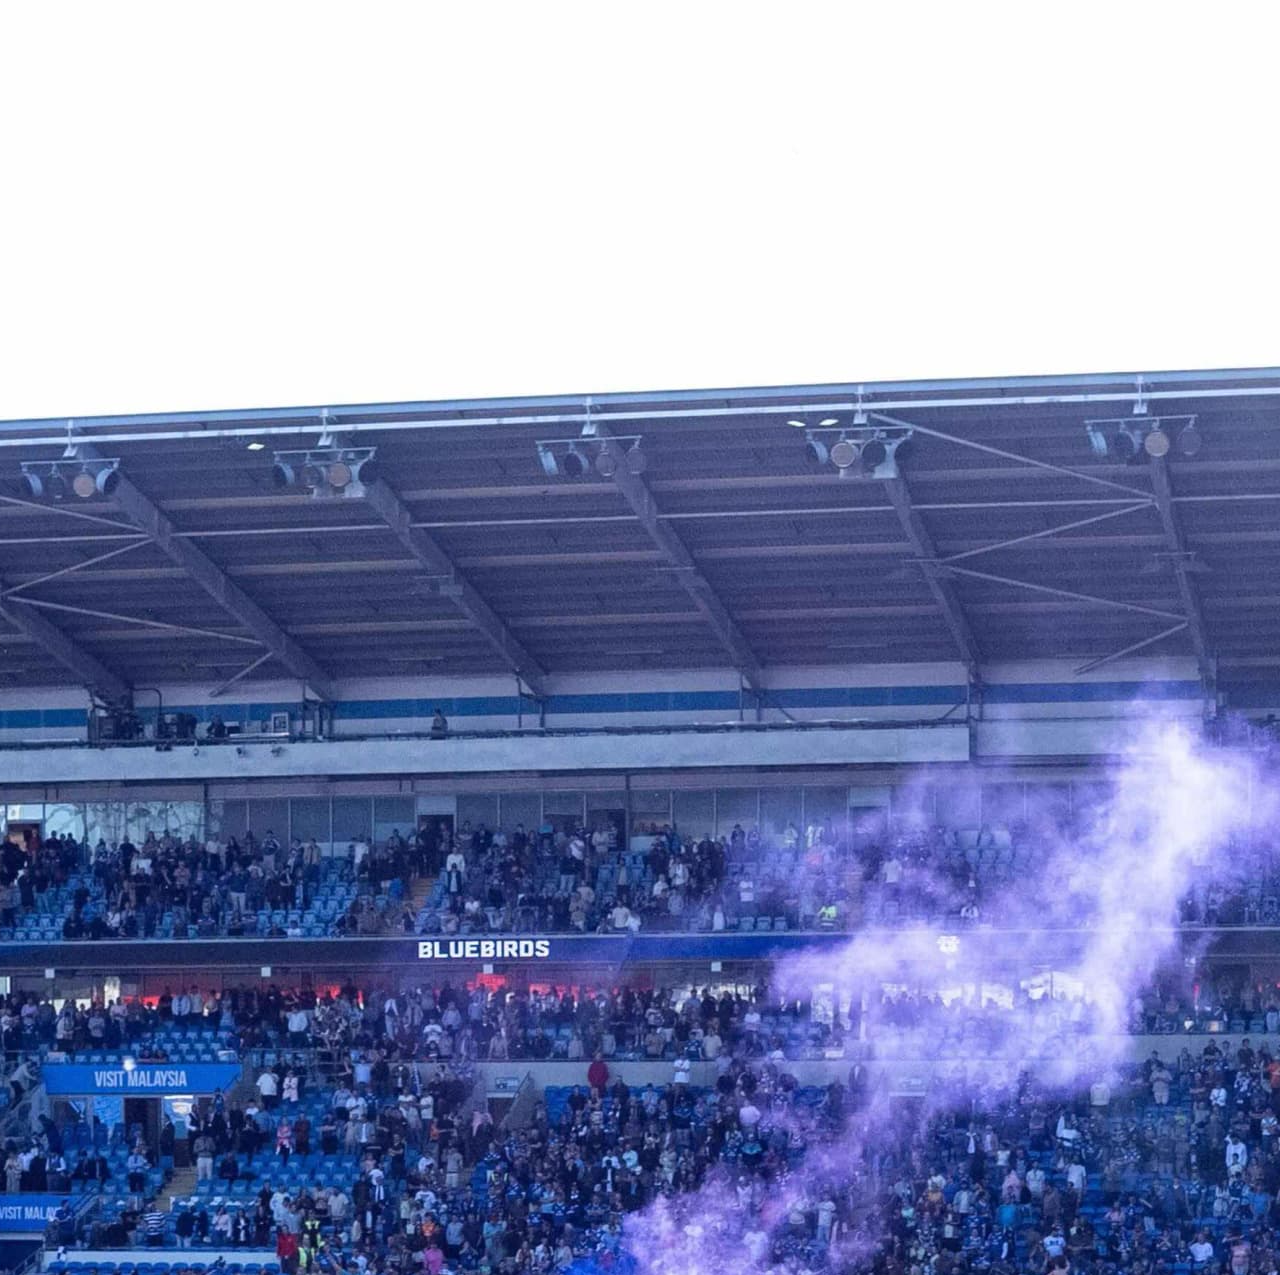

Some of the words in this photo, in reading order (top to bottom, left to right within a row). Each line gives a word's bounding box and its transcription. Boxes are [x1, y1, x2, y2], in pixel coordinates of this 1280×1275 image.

[417, 940, 550, 959] BLUEBIRDS
[94, 1070, 125, 1087] VISIT
[127, 1070, 188, 1087] MALAYSIA
